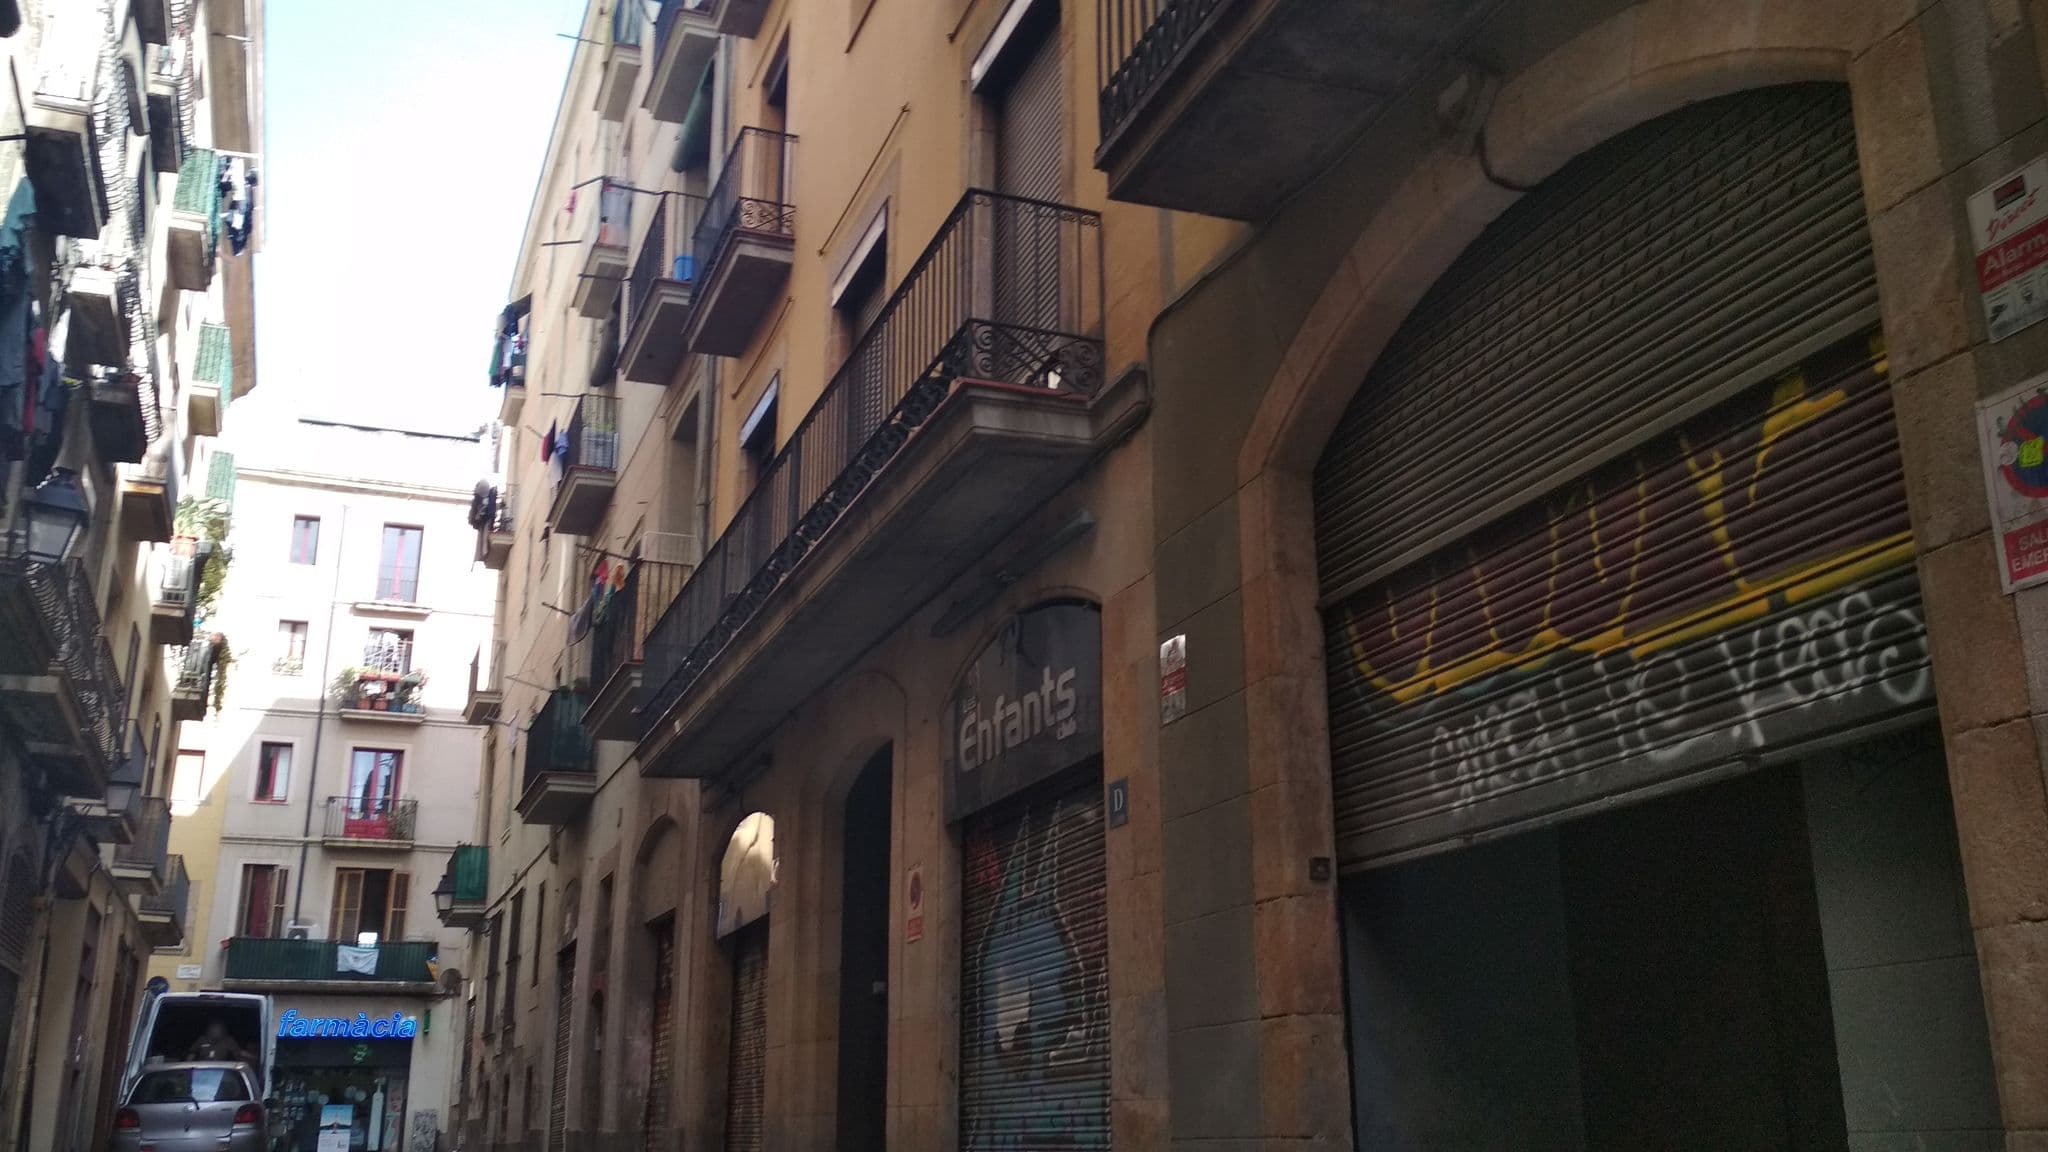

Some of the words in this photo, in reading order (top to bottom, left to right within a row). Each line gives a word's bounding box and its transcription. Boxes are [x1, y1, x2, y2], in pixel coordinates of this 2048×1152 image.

[1983, 233, 2048, 278] Alarm
[960, 667, 1076, 772] Enfants
[1113, 788, 1123, 812] D
[278, 1009, 418, 1038] farmàcia
